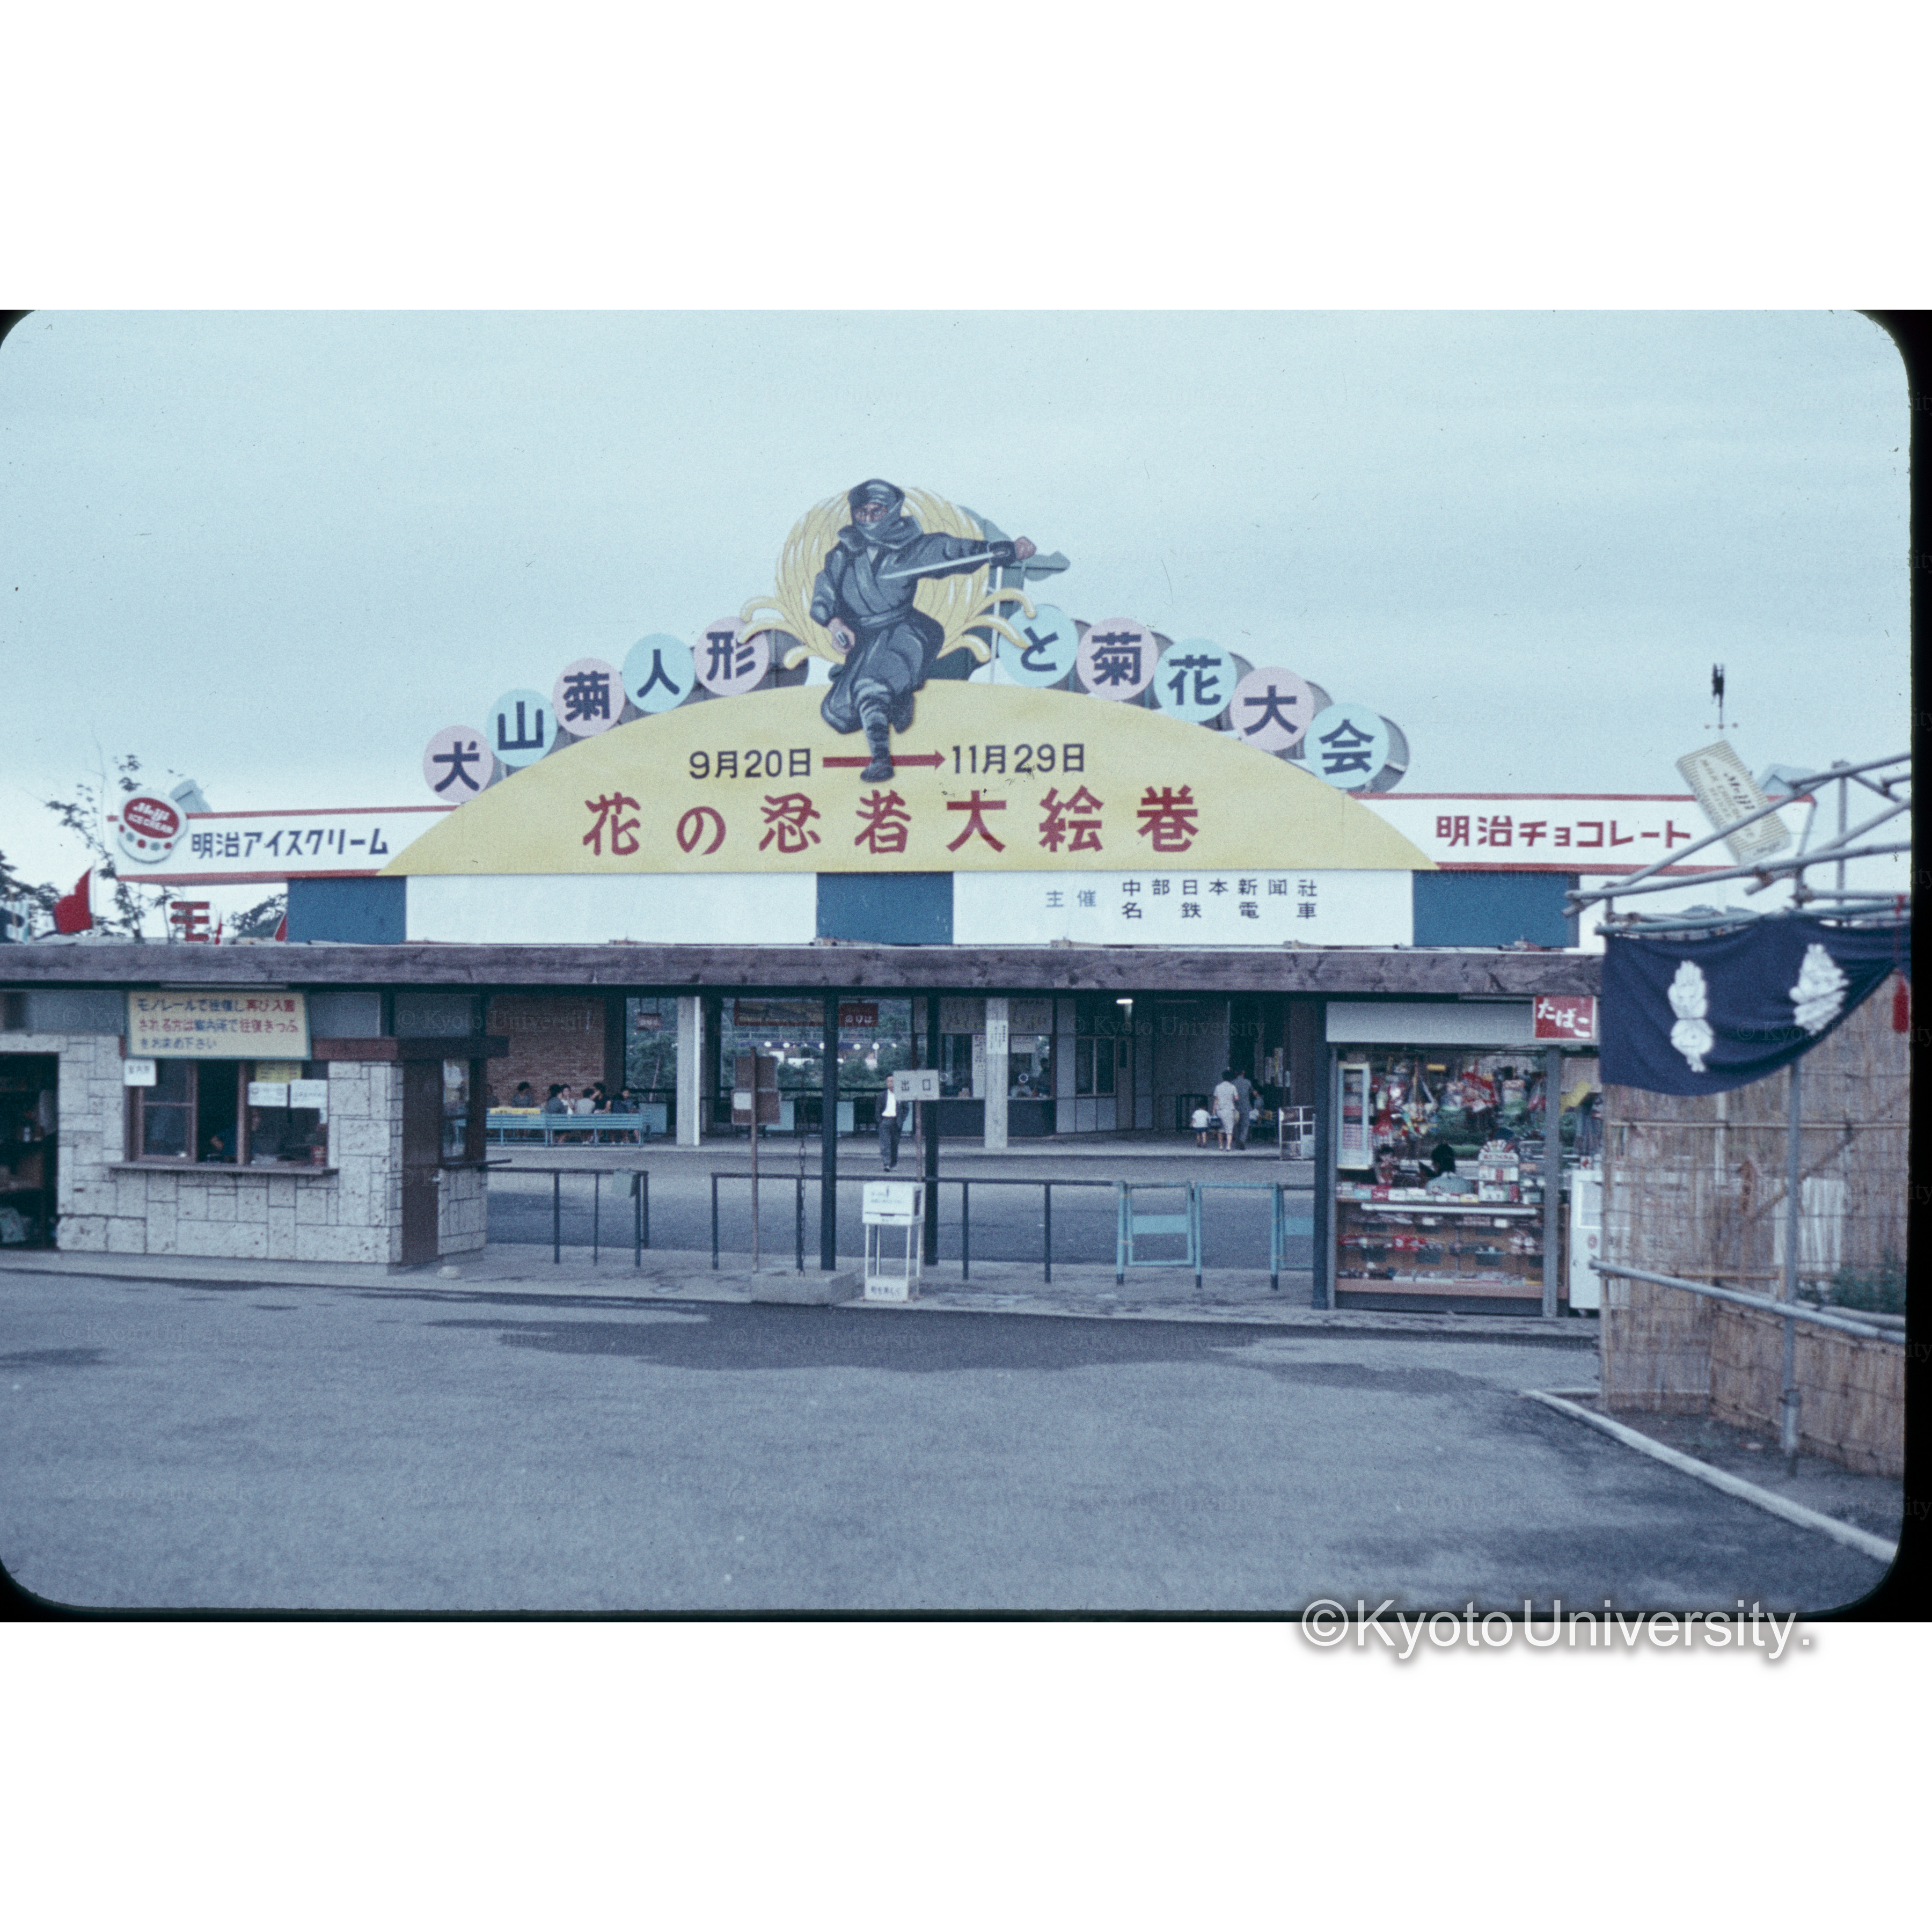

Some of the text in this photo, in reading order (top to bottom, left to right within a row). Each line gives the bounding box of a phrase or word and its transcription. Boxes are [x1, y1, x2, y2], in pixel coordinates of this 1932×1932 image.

[689, 743, 1085, 779] 9月20日 11月29日
[582, 785, 1199, 856] 花の忍者大絵巻
[1436, 815, 1691, 848] 明治チョコレート
[191, 828, 389, 859] 明治アイスクリーム
[1045, 890, 1097, 908] 主催
[1122, 879, 1318, 897] 中部日本新聞社
[1121, 902, 1318, 919] 名鉄電車
[1538, 999, 1591, 1037] たばこ
[901, 1078, 931, 1091] 出口
